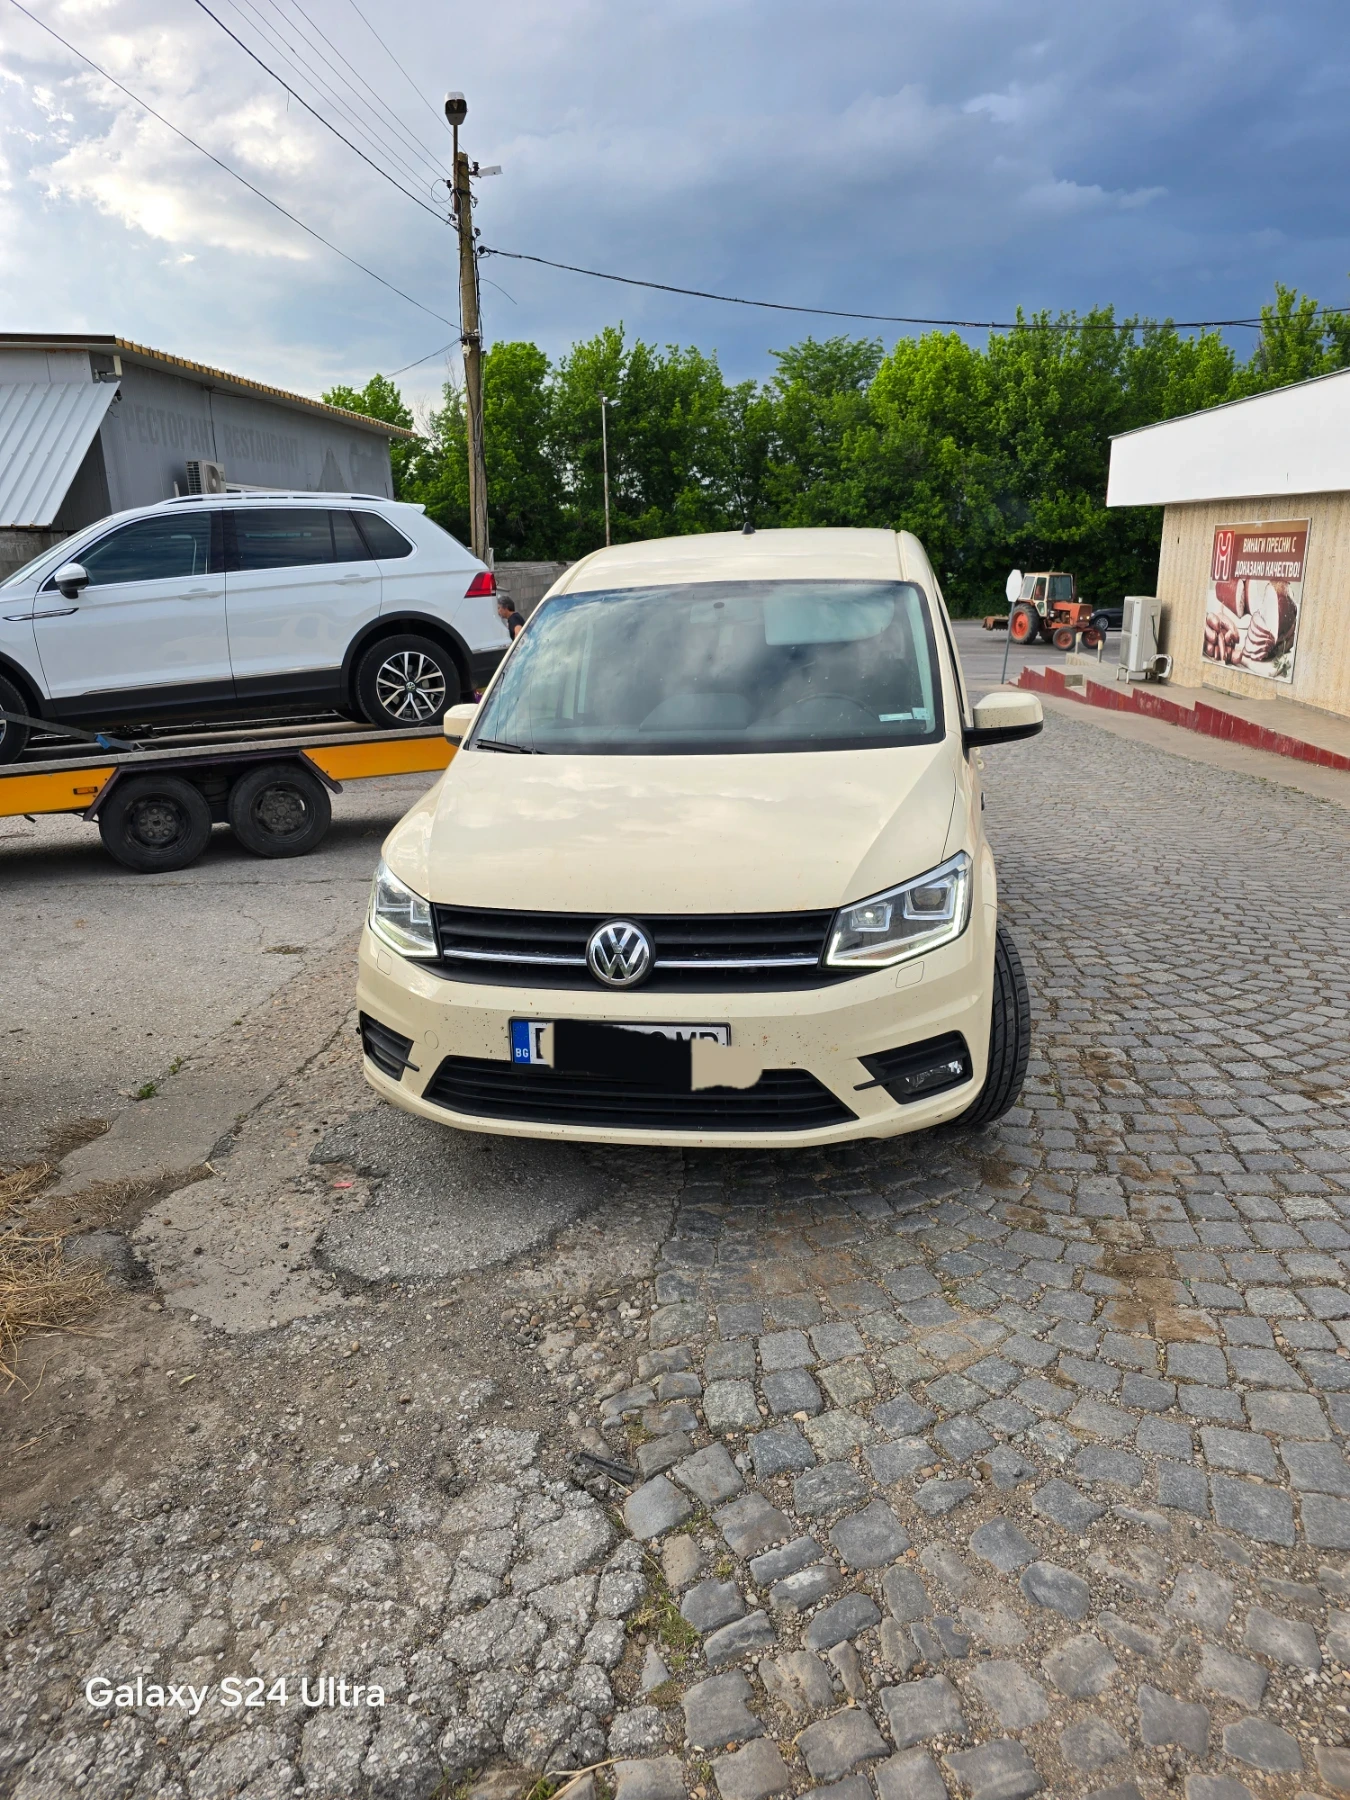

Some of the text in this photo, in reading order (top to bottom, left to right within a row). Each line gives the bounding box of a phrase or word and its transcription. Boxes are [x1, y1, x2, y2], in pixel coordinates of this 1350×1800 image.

[223, 424, 300, 469] RESTAURANT
[1243, 536, 1297, 553] ВИНАГИ ПРЕСНИ С
[515, 1047, 529, 1058] BG
